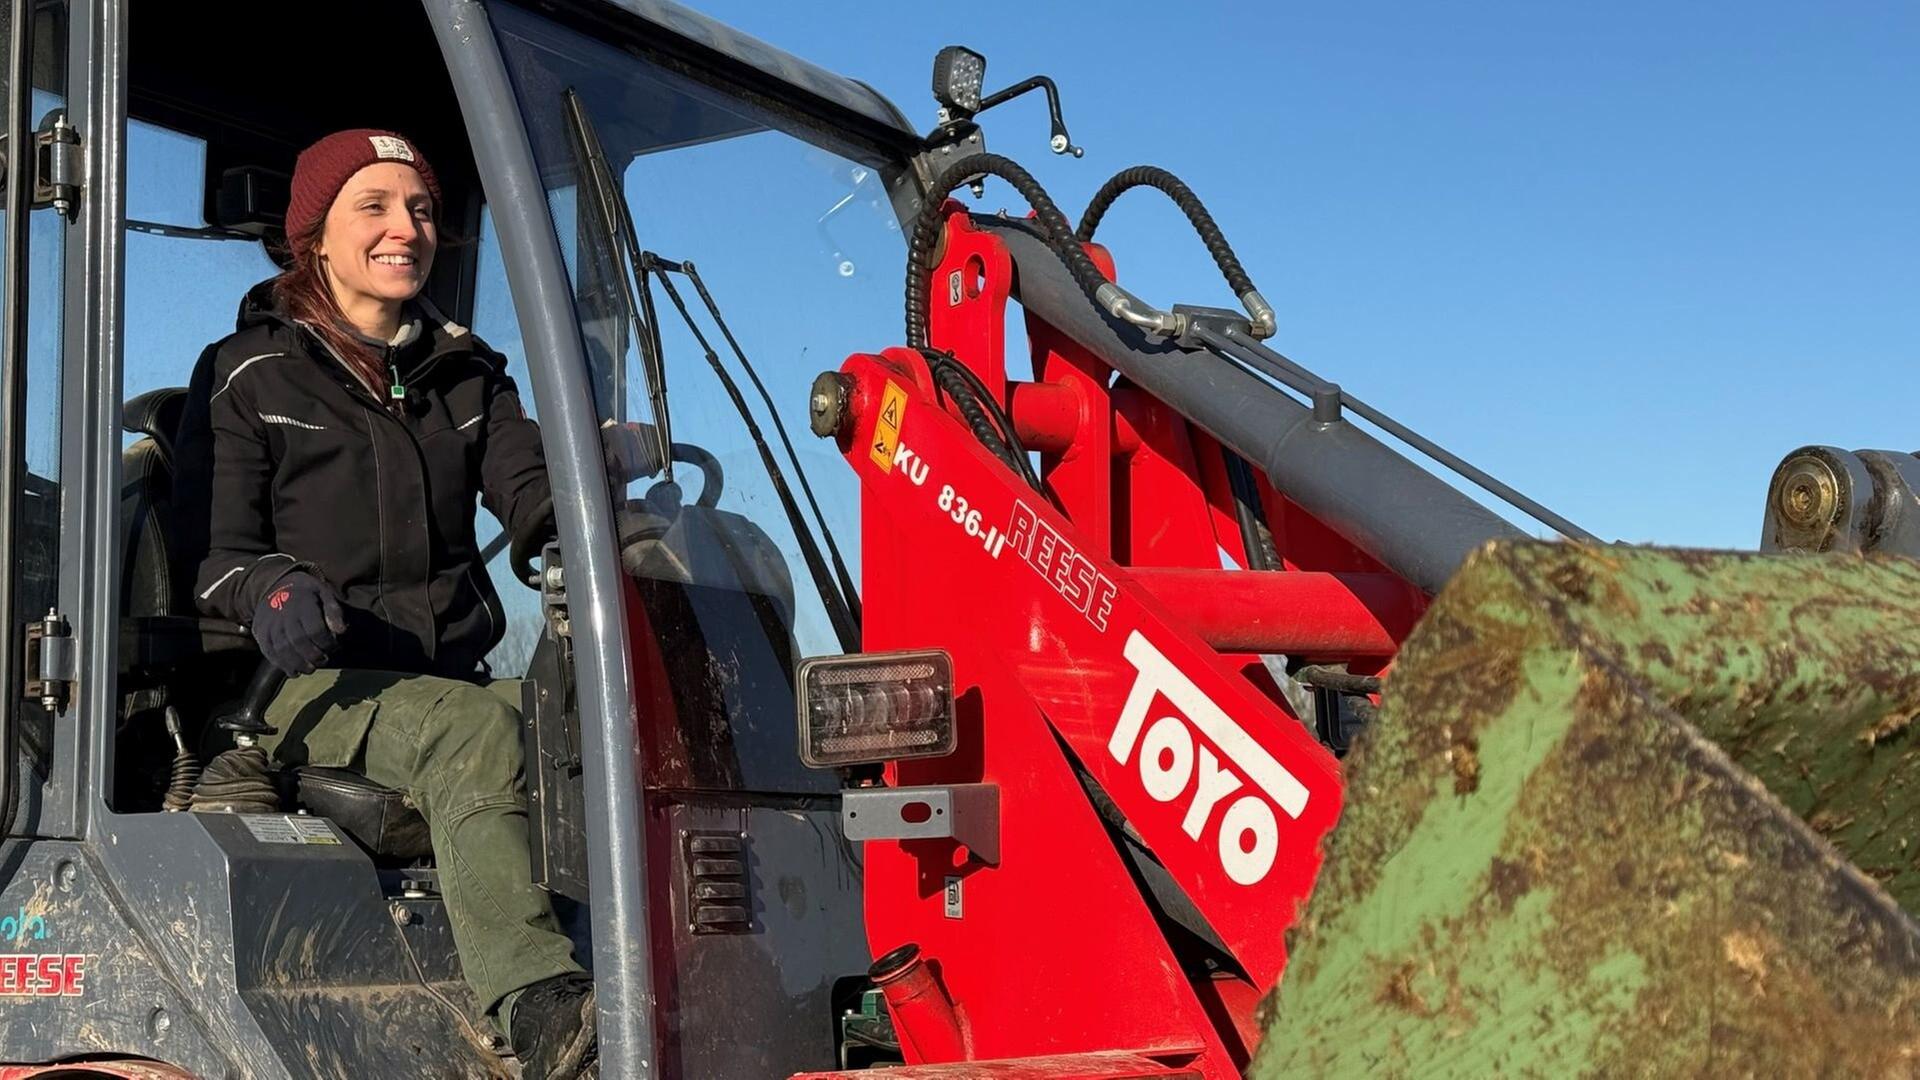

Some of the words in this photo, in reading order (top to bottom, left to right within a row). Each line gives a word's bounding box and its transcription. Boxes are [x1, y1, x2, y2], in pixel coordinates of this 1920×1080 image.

[893, 442, 930, 486] KU
[938, 484, 1006, 560] 836-II
[1006, 498, 1117, 633] REESE
[1107, 628, 1310, 886] TOYO
